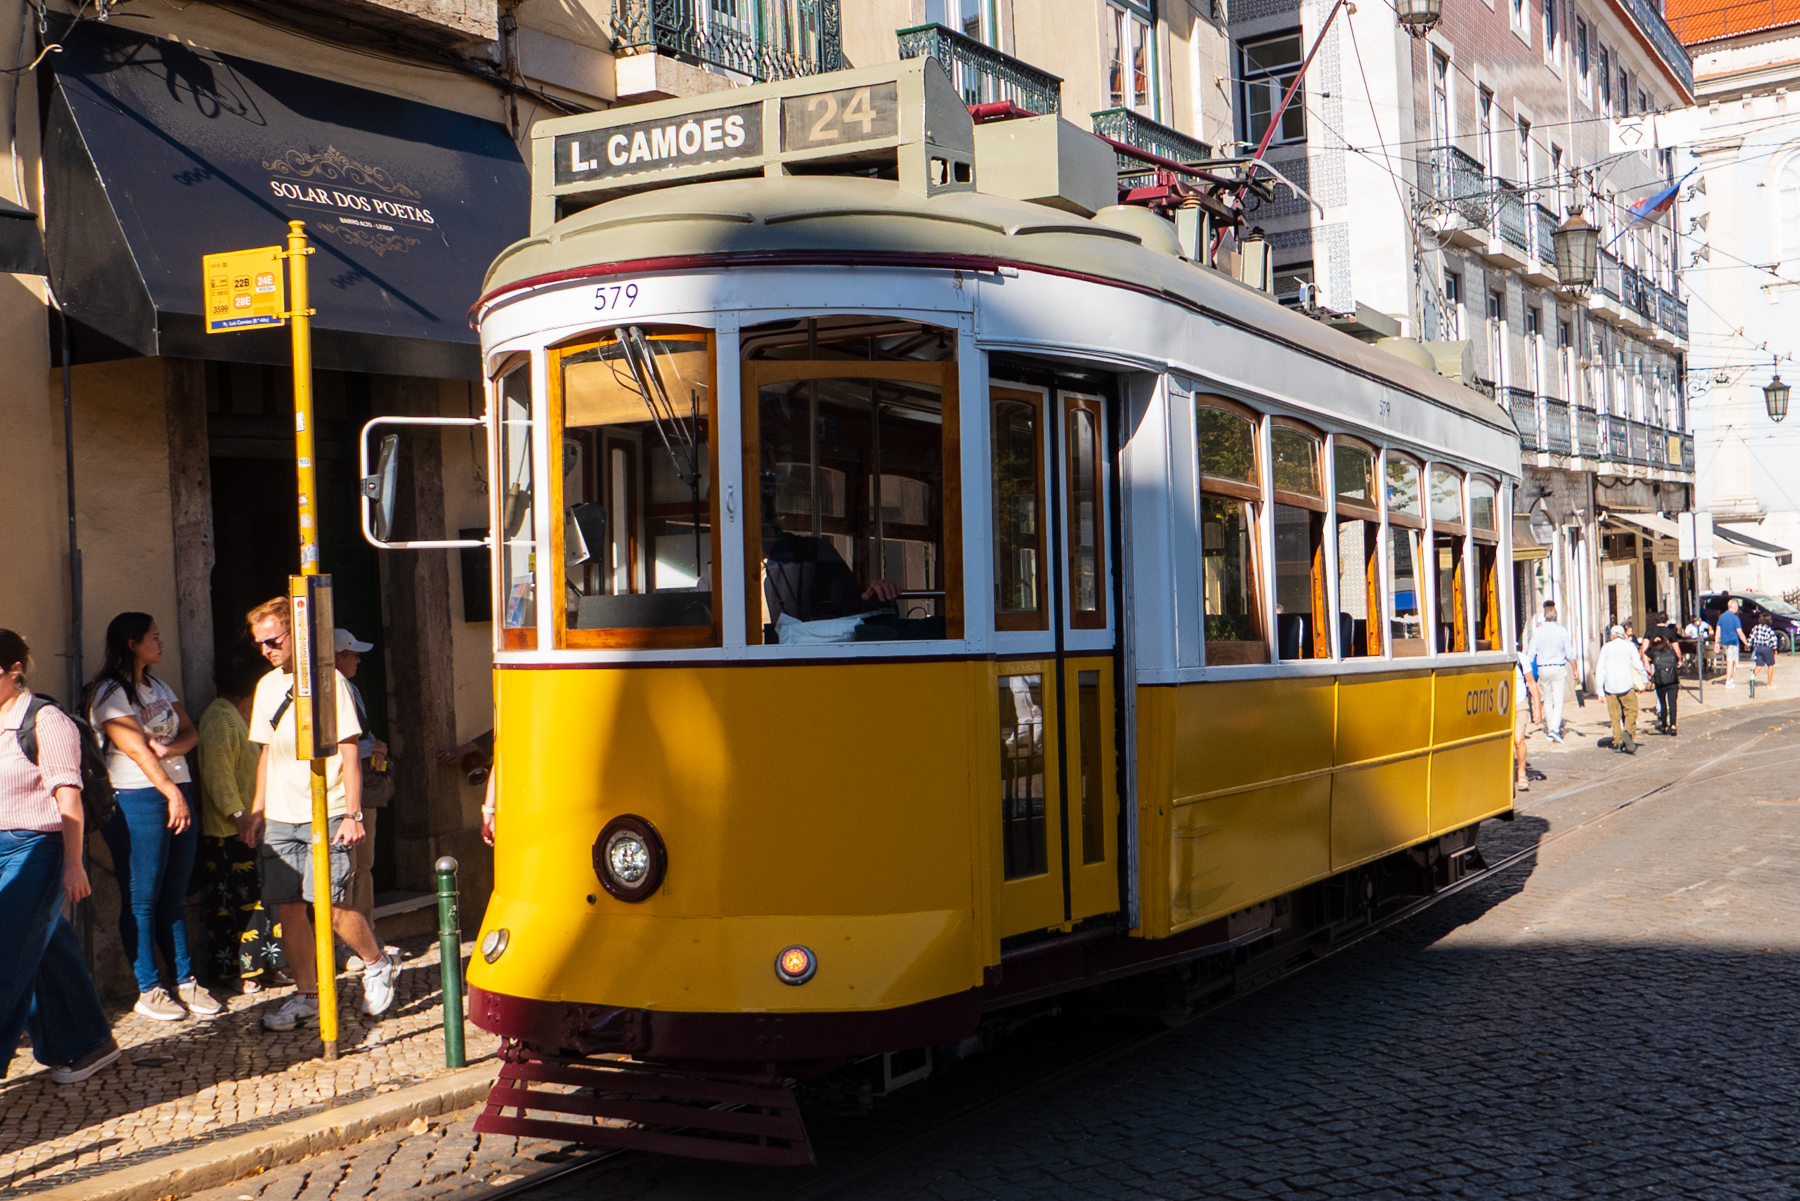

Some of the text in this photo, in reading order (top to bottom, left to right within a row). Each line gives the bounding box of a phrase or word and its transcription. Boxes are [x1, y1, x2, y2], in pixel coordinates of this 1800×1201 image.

[807, 87, 876, 141] 24
[570, 141, 598, 173] L.
[607, 115, 746, 166] CAMÕES
[270, 180, 435, 224] SOLAR DOS POETAS
[234, 278, 250, 288] 22B
[257, 275, 273, 286] 24E
[235, 296, 251, 307] 28E
[594, 283, 638, 311] 579
[1379, 400, 1391, 418] 579
[1465, 678, 1494, 716] carris
